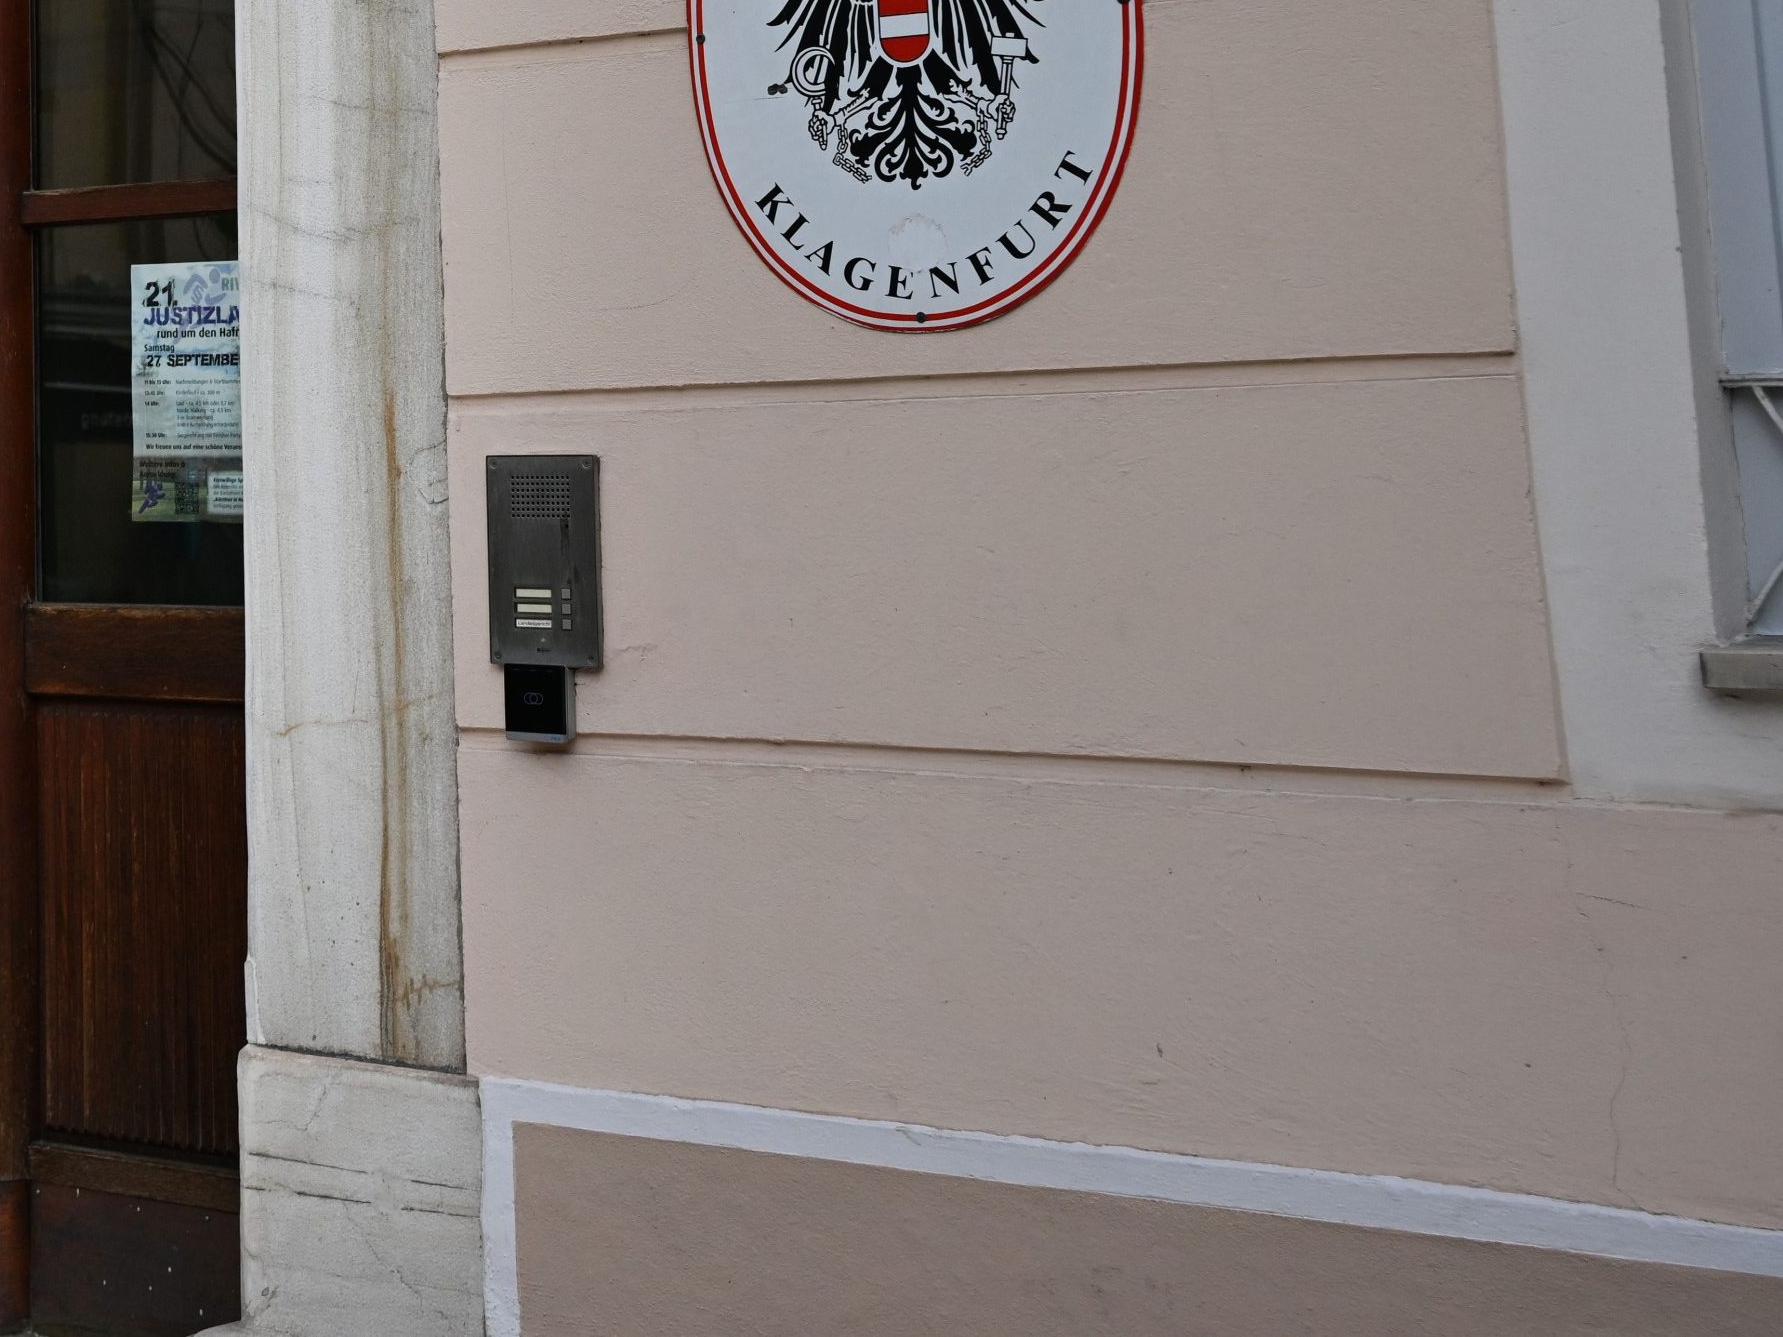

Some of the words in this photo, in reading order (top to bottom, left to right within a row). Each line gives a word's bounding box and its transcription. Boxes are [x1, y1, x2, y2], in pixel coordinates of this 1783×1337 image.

[755, 150, 1093, 300] KLAGENFURT
[157, 328, 178, 338] rund
[181, 330, 195, 338] um
[199, 327, 216, 338] den
[144, 344, 175, 353] Samstag
